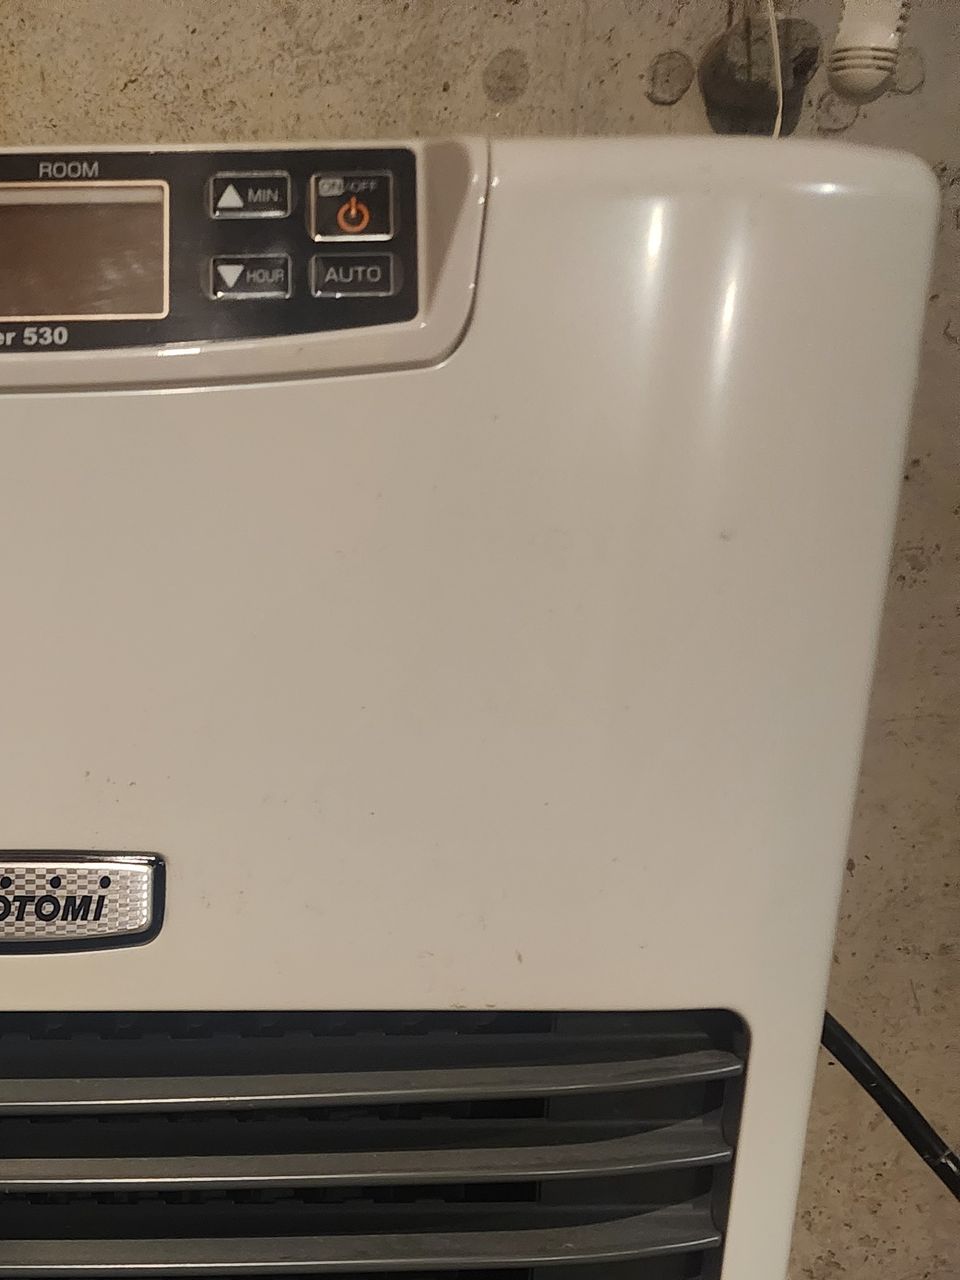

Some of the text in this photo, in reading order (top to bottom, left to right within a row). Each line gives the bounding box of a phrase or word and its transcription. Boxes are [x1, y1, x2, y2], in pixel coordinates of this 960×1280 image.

[39, 161, 99, 178] ROOM
[248, 188, 279, 202] MIN
[246, 269, 285, 283] HOUR
[324, 266, 381, 283] AUTO
[23, 326, 68, 346] 530
